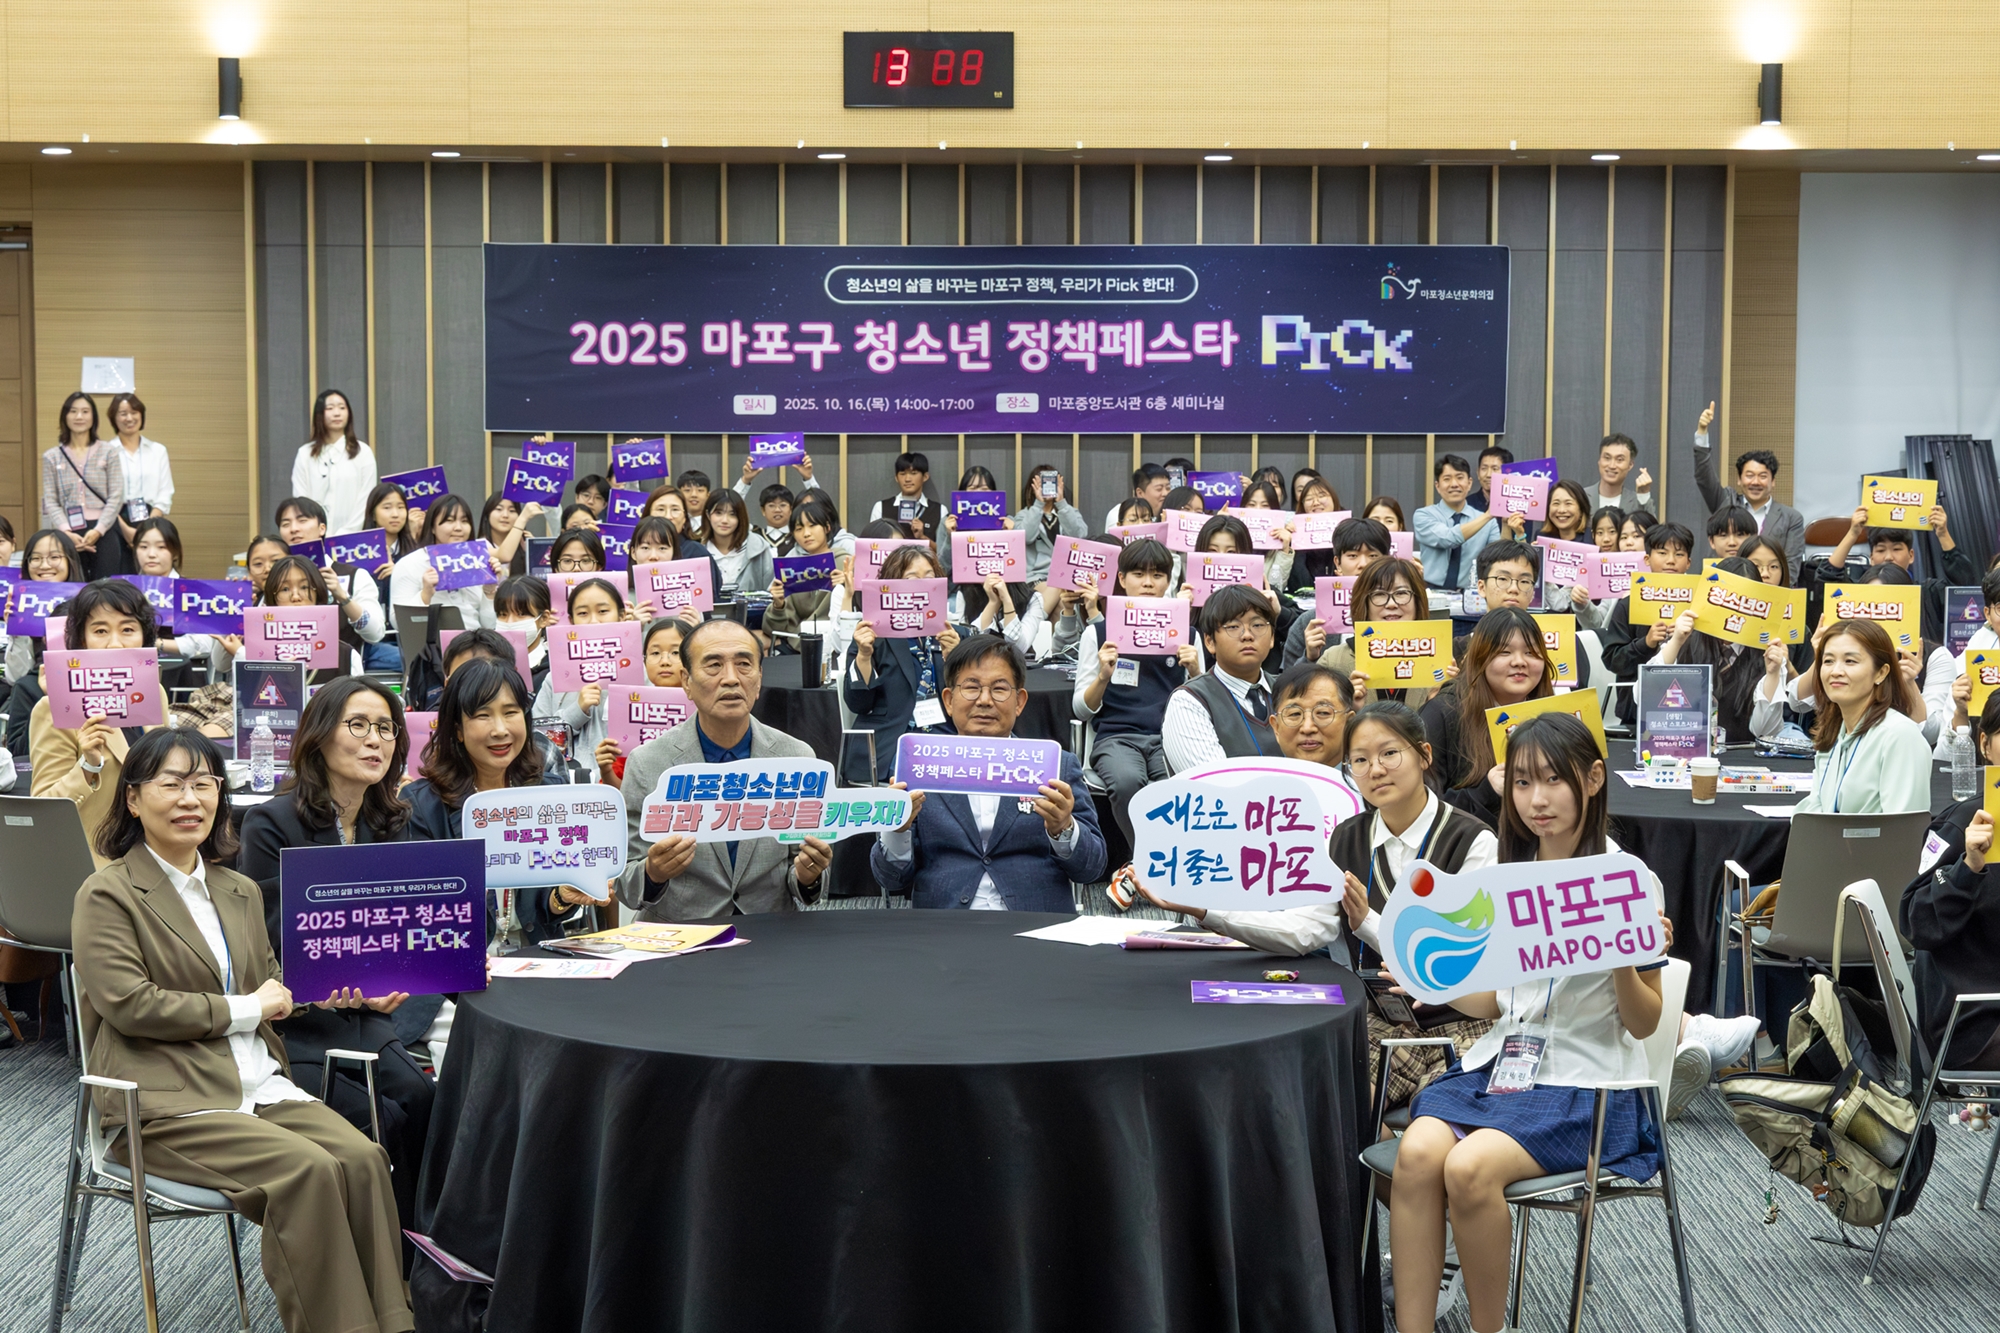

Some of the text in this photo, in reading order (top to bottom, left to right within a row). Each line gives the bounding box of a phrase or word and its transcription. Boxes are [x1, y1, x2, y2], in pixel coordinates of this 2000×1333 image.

[846, 277, 1174, 294] 청소년의 삶을 바꾸는 마포구 정책, 우리가 Pick 한다!
[1420, 289, 1494, 300] 마포청소년문화의집
[569, 320, 688, 366] 2025
[701, 319, 841, 372] 마포구
[853, 319, 992, 373] 청소년
[1006, 319, 1240, 374] 정책페스타
[743, 396, 1225, 412] 일시 2025. 10. 16.(목) 14:00~17:00 장소 마포중앙도서관 6층 세미나실
[1501, 484, 1535, 499] 마포구
[1872, 489, 1923, 507] 청소년의
[1506, 499, 1529, 514] 정책
[1890, 506, 1907, 522] 삶
[967, 541, 1010, 560] 마포구
[1067, 550, 1107, 570] 마포구
[1549, 549, 1584, 566] 마포구
[976, 559, 1005, 576] 정책
[1203, 565, 1247, 582] 마포구
[1553, 565, 1578, 581] 정책
[1600, 562, 1639, 577] 마포구
[652, 571, 696, 592] 마포구
[662, 590, 692, 609] 정책
[880, 592, 930, 611] 마포구
[1641, 586, 1693, 603] 청소년의
[1708, 586, 1772, 620] 청소년의
[1125, 608, 1172, 629] 마포구
[1659, 603, 1676, 619] 삶
[1836, 601, 1904, 620] 청소년의
[1964, 604, 1979, 619] 6
[264, 621, 318, 641] 마포구
[890, 613, 924, 631] 정책
[1724, 614, 1745, 634] 삶
[1133, 628, 1167, 648] 정책
[275, 643, 312, 662] 정책
[568, 637, 623, 661] 마포구
[1369, 638, 1436, 659] 청소년의
[69, 667, 135, 692] 마포구
[579, 661, 618, 683] 정책
[1396, 661, 1413, 679] 삶
[259, 685, 278, 705] 4
[1666, 689, 1684, 707] 5
[82, 695, 129, 720] 정책
[629, 702, 687, 726] 마포구
[912, 744, 1044, 764] 2025 마포구 청소년
[911, 764, 982, 780] 정책페스타
[665, 770, 829, 802] 마포청소년의
[472, 801, 618, 829] 청소년의 삶을 바꾸는
[644, 799, 906, 833] 꿈과 가능성을 키우자!
[1145, 792, 1238, 833] 새로운
[1244, 795, 1316, 836] 마포
[504, 825, 589, 846] 마포구 정책
[582, 846, 618, 867] 한다!
[1240, 841, 1332, 897] 마포
[315, 882, 457, 897] 청소년의 삶을 바꾸는 마포구 정책, 우리가 Pick 한다!
[1506, 869, 1647, 937] 마포구
[296, 902, 472, 931] 2025 마포구 청소년
[302, 933, 401, 960] 정책페스타
[1518, 924, 1656, 972] MAPO-GU
